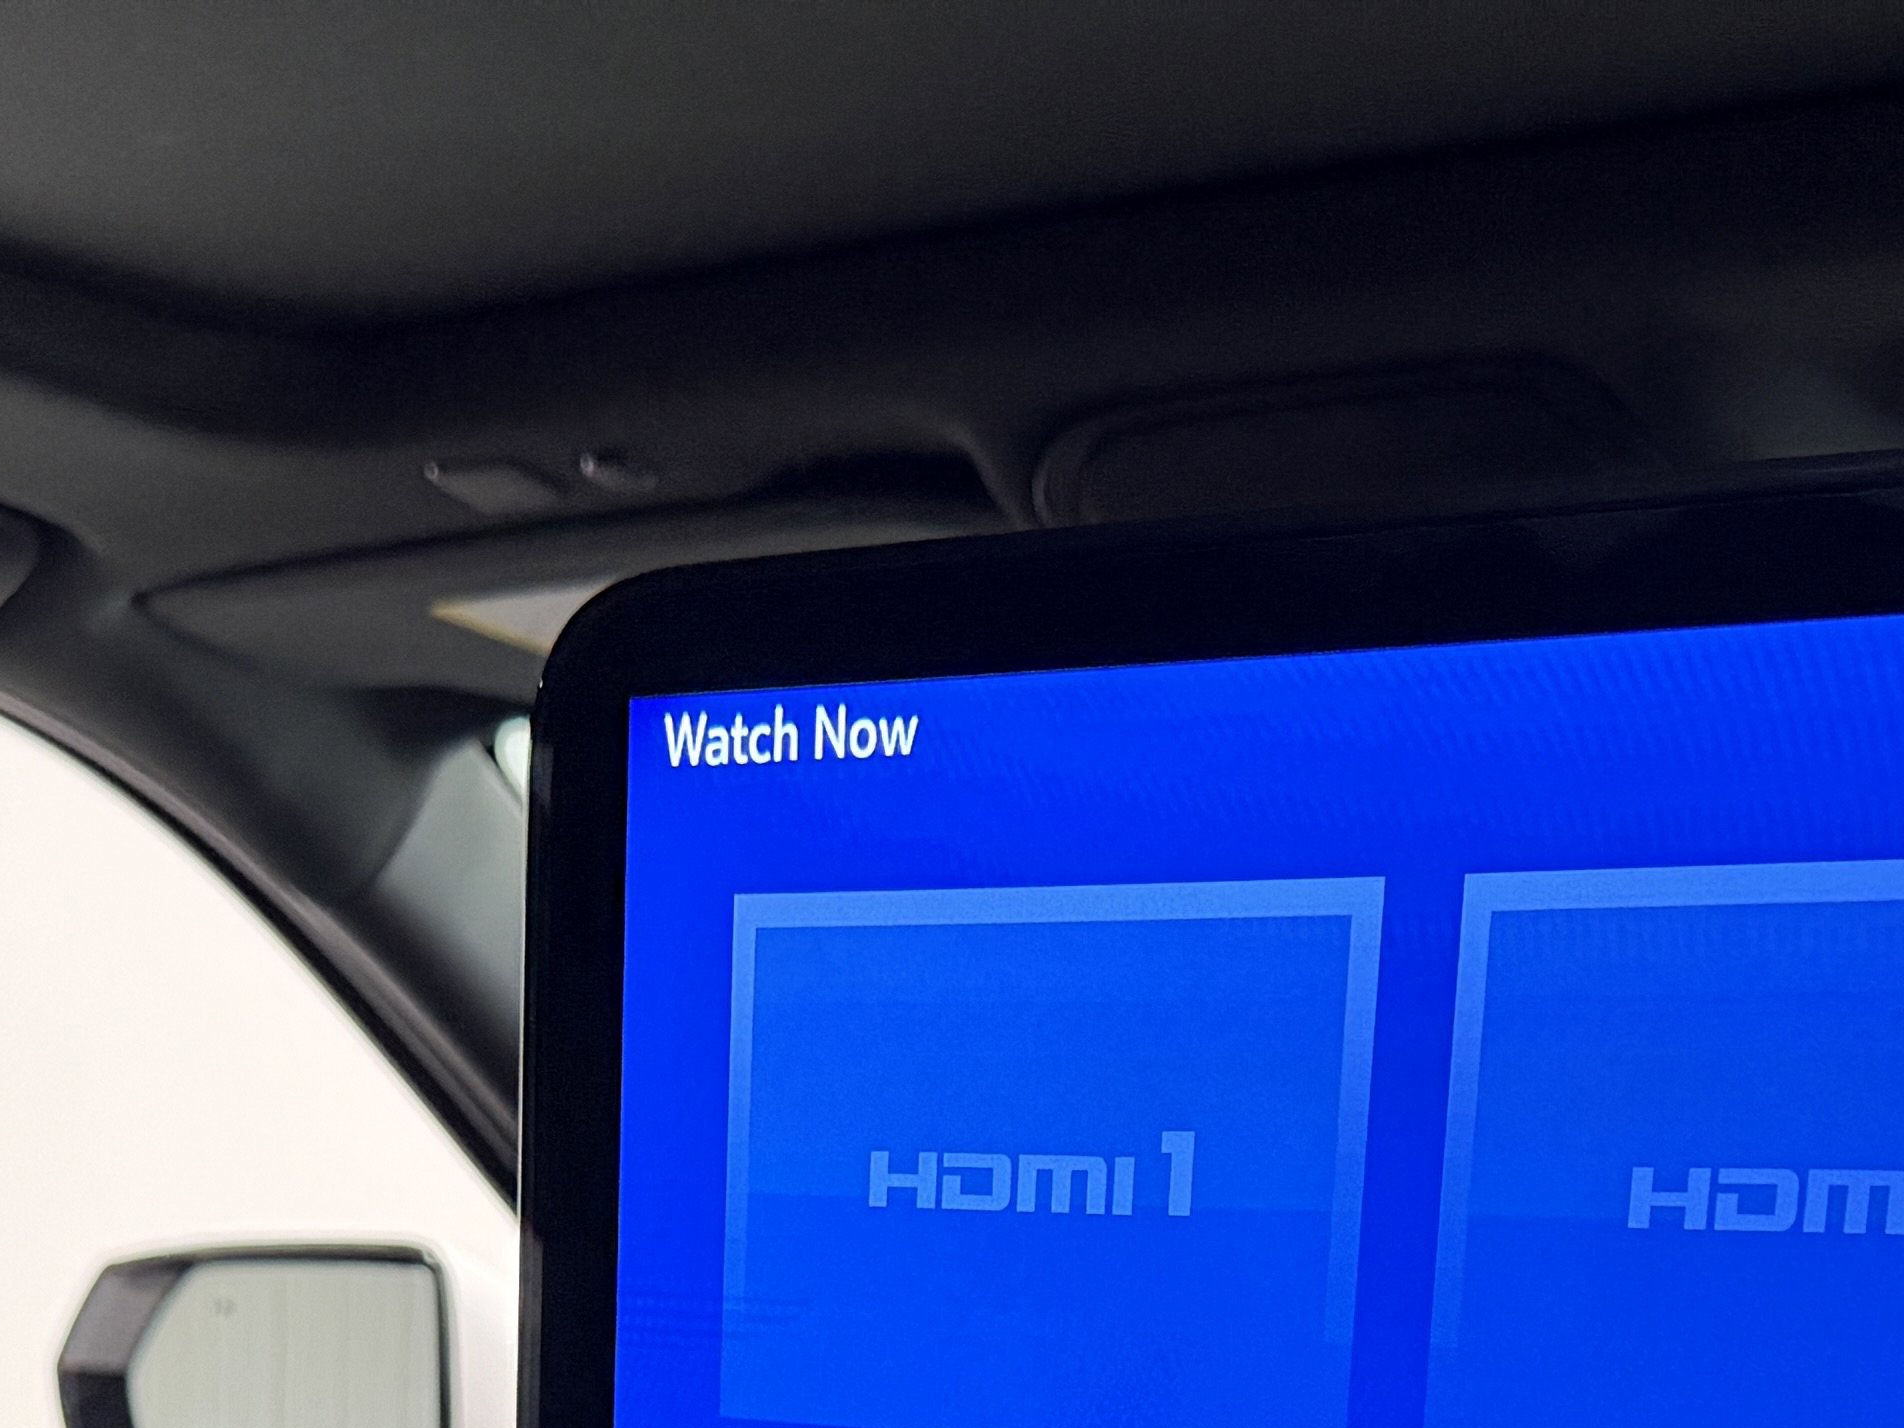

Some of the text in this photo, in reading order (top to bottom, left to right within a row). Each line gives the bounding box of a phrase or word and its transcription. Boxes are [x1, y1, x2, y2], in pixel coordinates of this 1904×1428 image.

[664, 702, 919, 767] Watch Now
[869, 1131, 1195, 1217] HDMI 1
